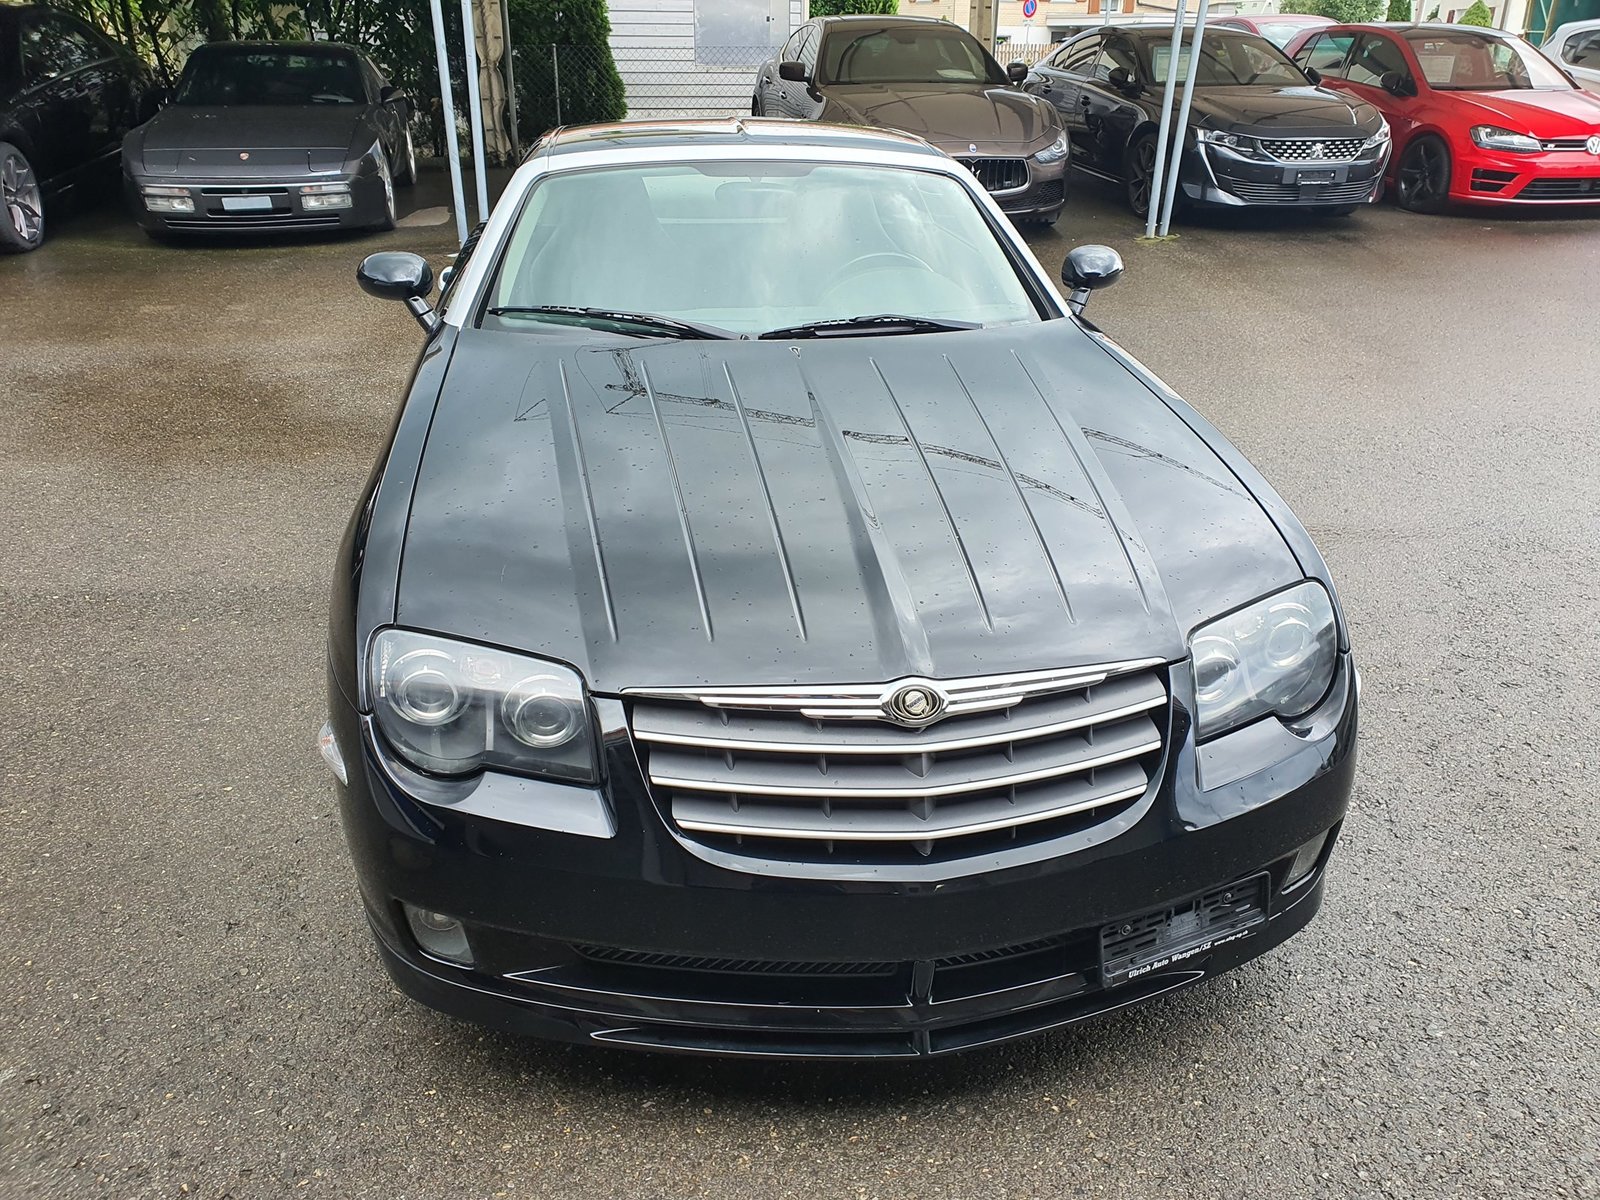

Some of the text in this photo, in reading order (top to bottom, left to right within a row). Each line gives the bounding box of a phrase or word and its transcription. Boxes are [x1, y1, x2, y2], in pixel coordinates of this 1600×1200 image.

[1128, 965, 1151, 979] Ulrich
[1151, 959, 1169, 970] Auto
[1171, 941, 1212, 961] Wangen/SZ
